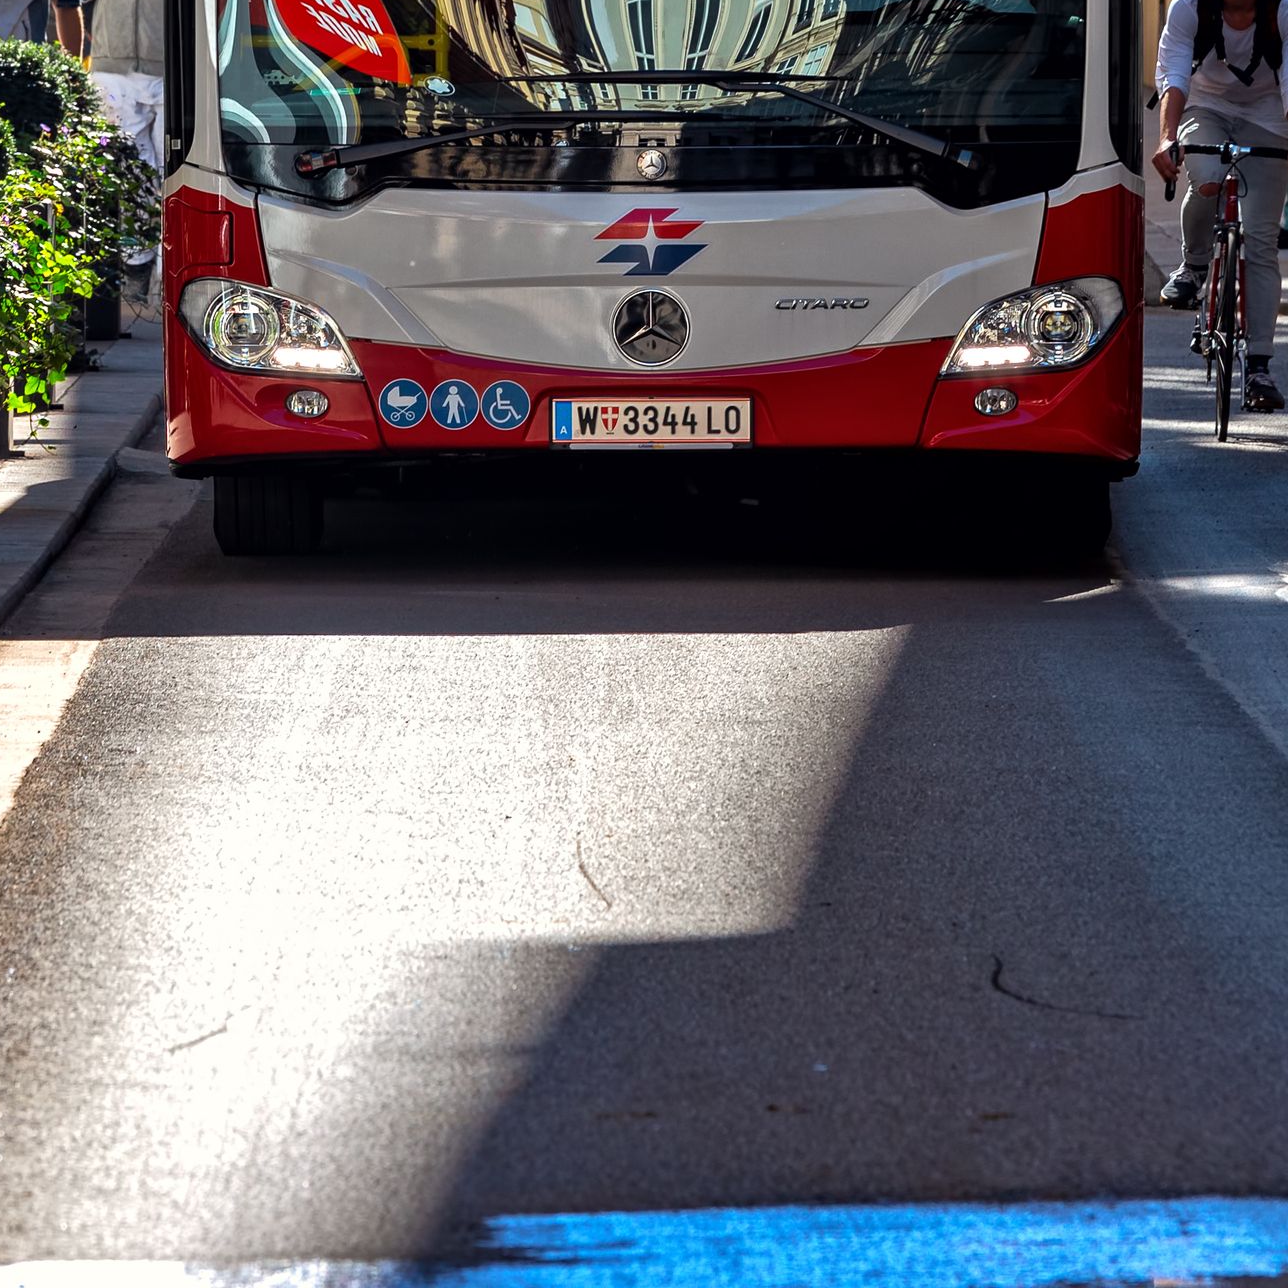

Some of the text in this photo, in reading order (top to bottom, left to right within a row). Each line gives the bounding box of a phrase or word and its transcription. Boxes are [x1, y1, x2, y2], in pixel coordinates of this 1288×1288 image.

[775, 297, 870, 310] CITARO
[577, 405, 599, 435] W
[623, 405, 698, 435] 3344
